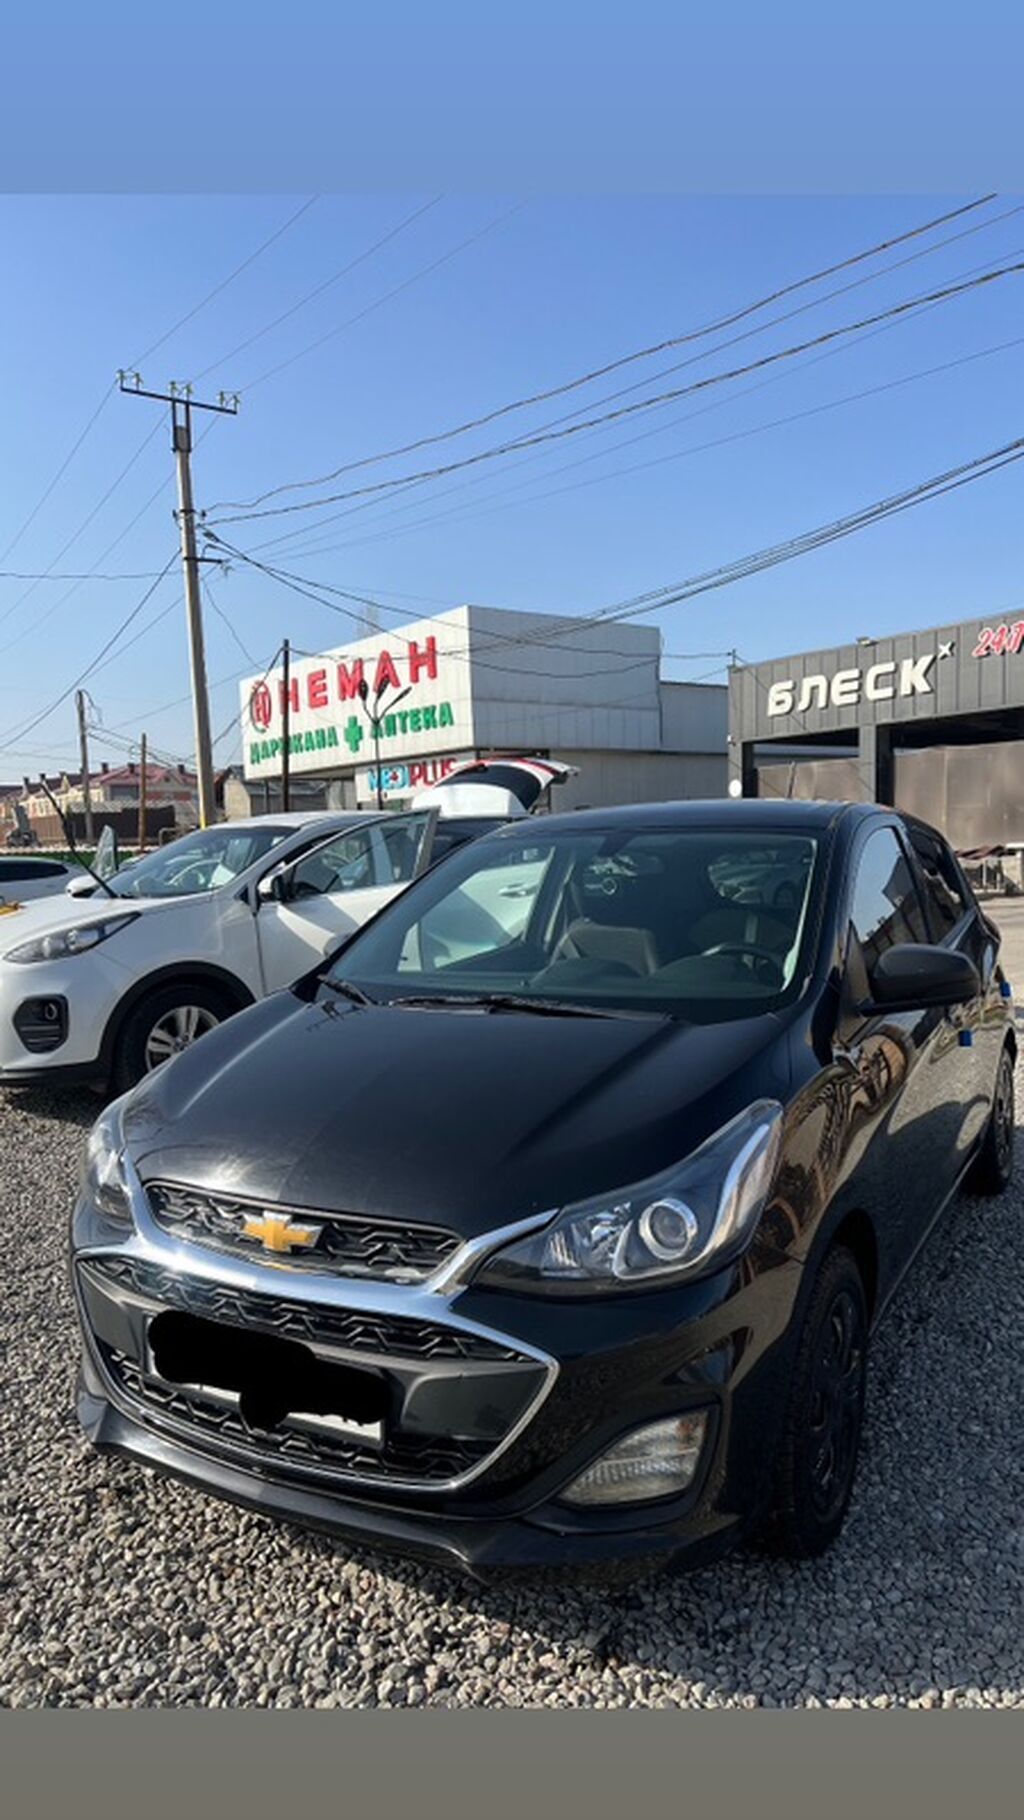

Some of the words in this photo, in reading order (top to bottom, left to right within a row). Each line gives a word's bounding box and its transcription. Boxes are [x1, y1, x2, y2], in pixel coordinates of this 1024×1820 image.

[278, 636, 438, 715] НЕМАН
[766, 654, 936, 717] БЛЕСК
[370, 702, 455, 740] АПТЕКА
